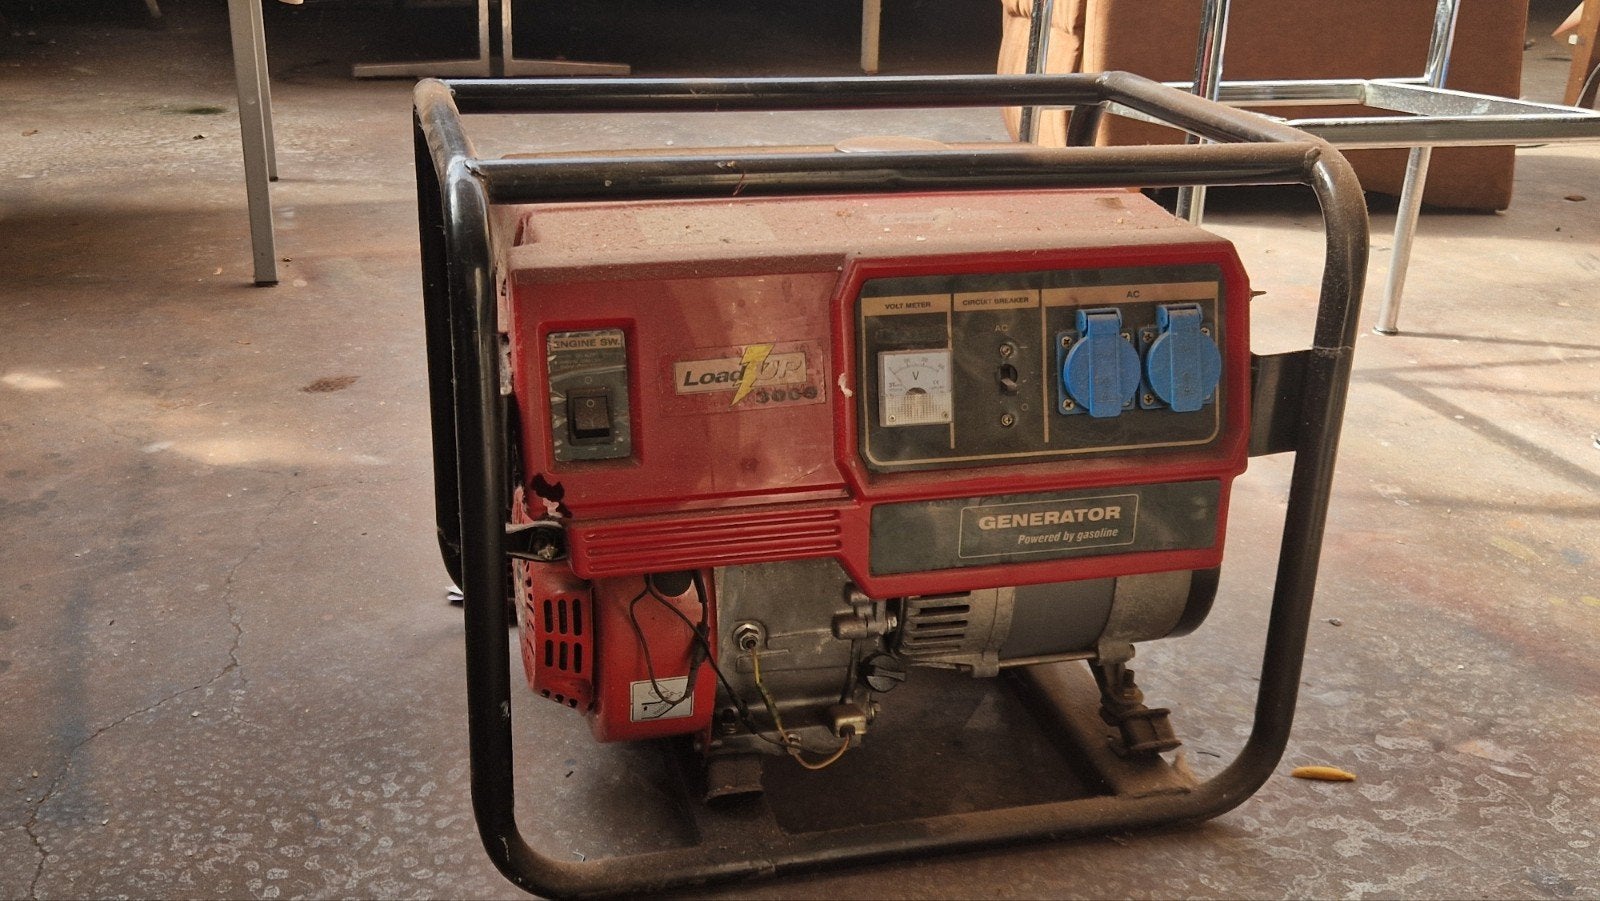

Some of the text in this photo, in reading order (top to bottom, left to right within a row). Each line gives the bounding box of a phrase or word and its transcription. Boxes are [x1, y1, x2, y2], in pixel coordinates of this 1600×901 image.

[1126, 290, 1140, 298] AC
[962, 297, 1029, 306] CIRCUIT BREAKER
[994, 324, 1008, 332] AC
[683, 364, 747, 387] Load
[912, 370, 920, 381] V
[978, 506, 1121, 531] GENERATOR
[1017, 527, 1119, 545] Powered by gasoline
